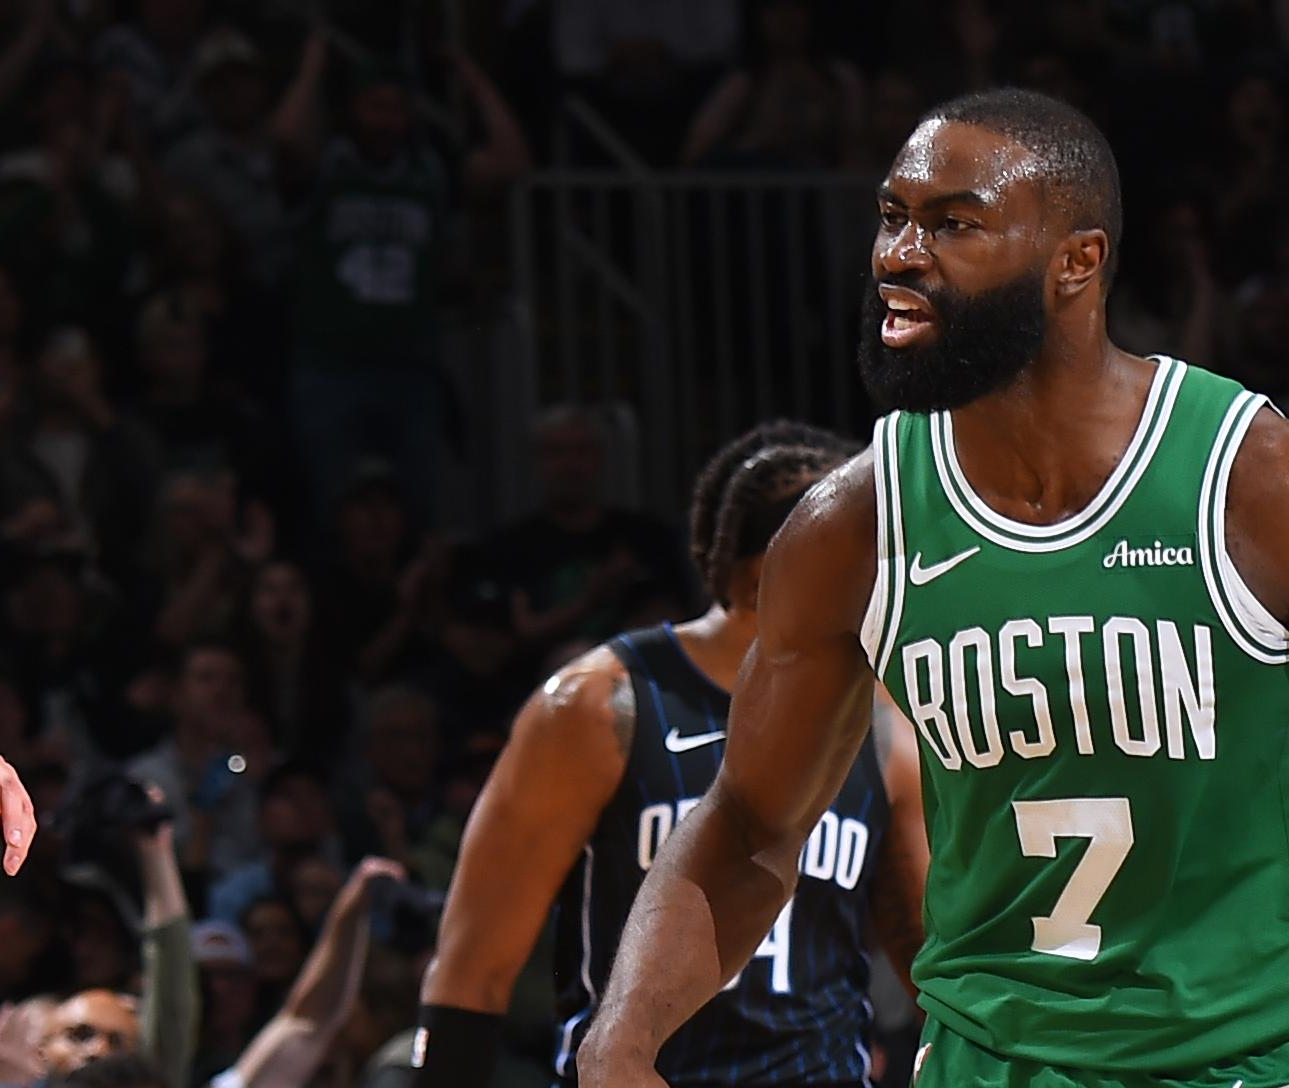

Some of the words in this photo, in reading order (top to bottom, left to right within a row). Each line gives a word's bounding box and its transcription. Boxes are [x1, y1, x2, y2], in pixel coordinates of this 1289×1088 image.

[1103, 540, 1194, 568] Amica
[902, 616, 1216, 770] BOSTON
[1012, 797, 1134, 960] 7
